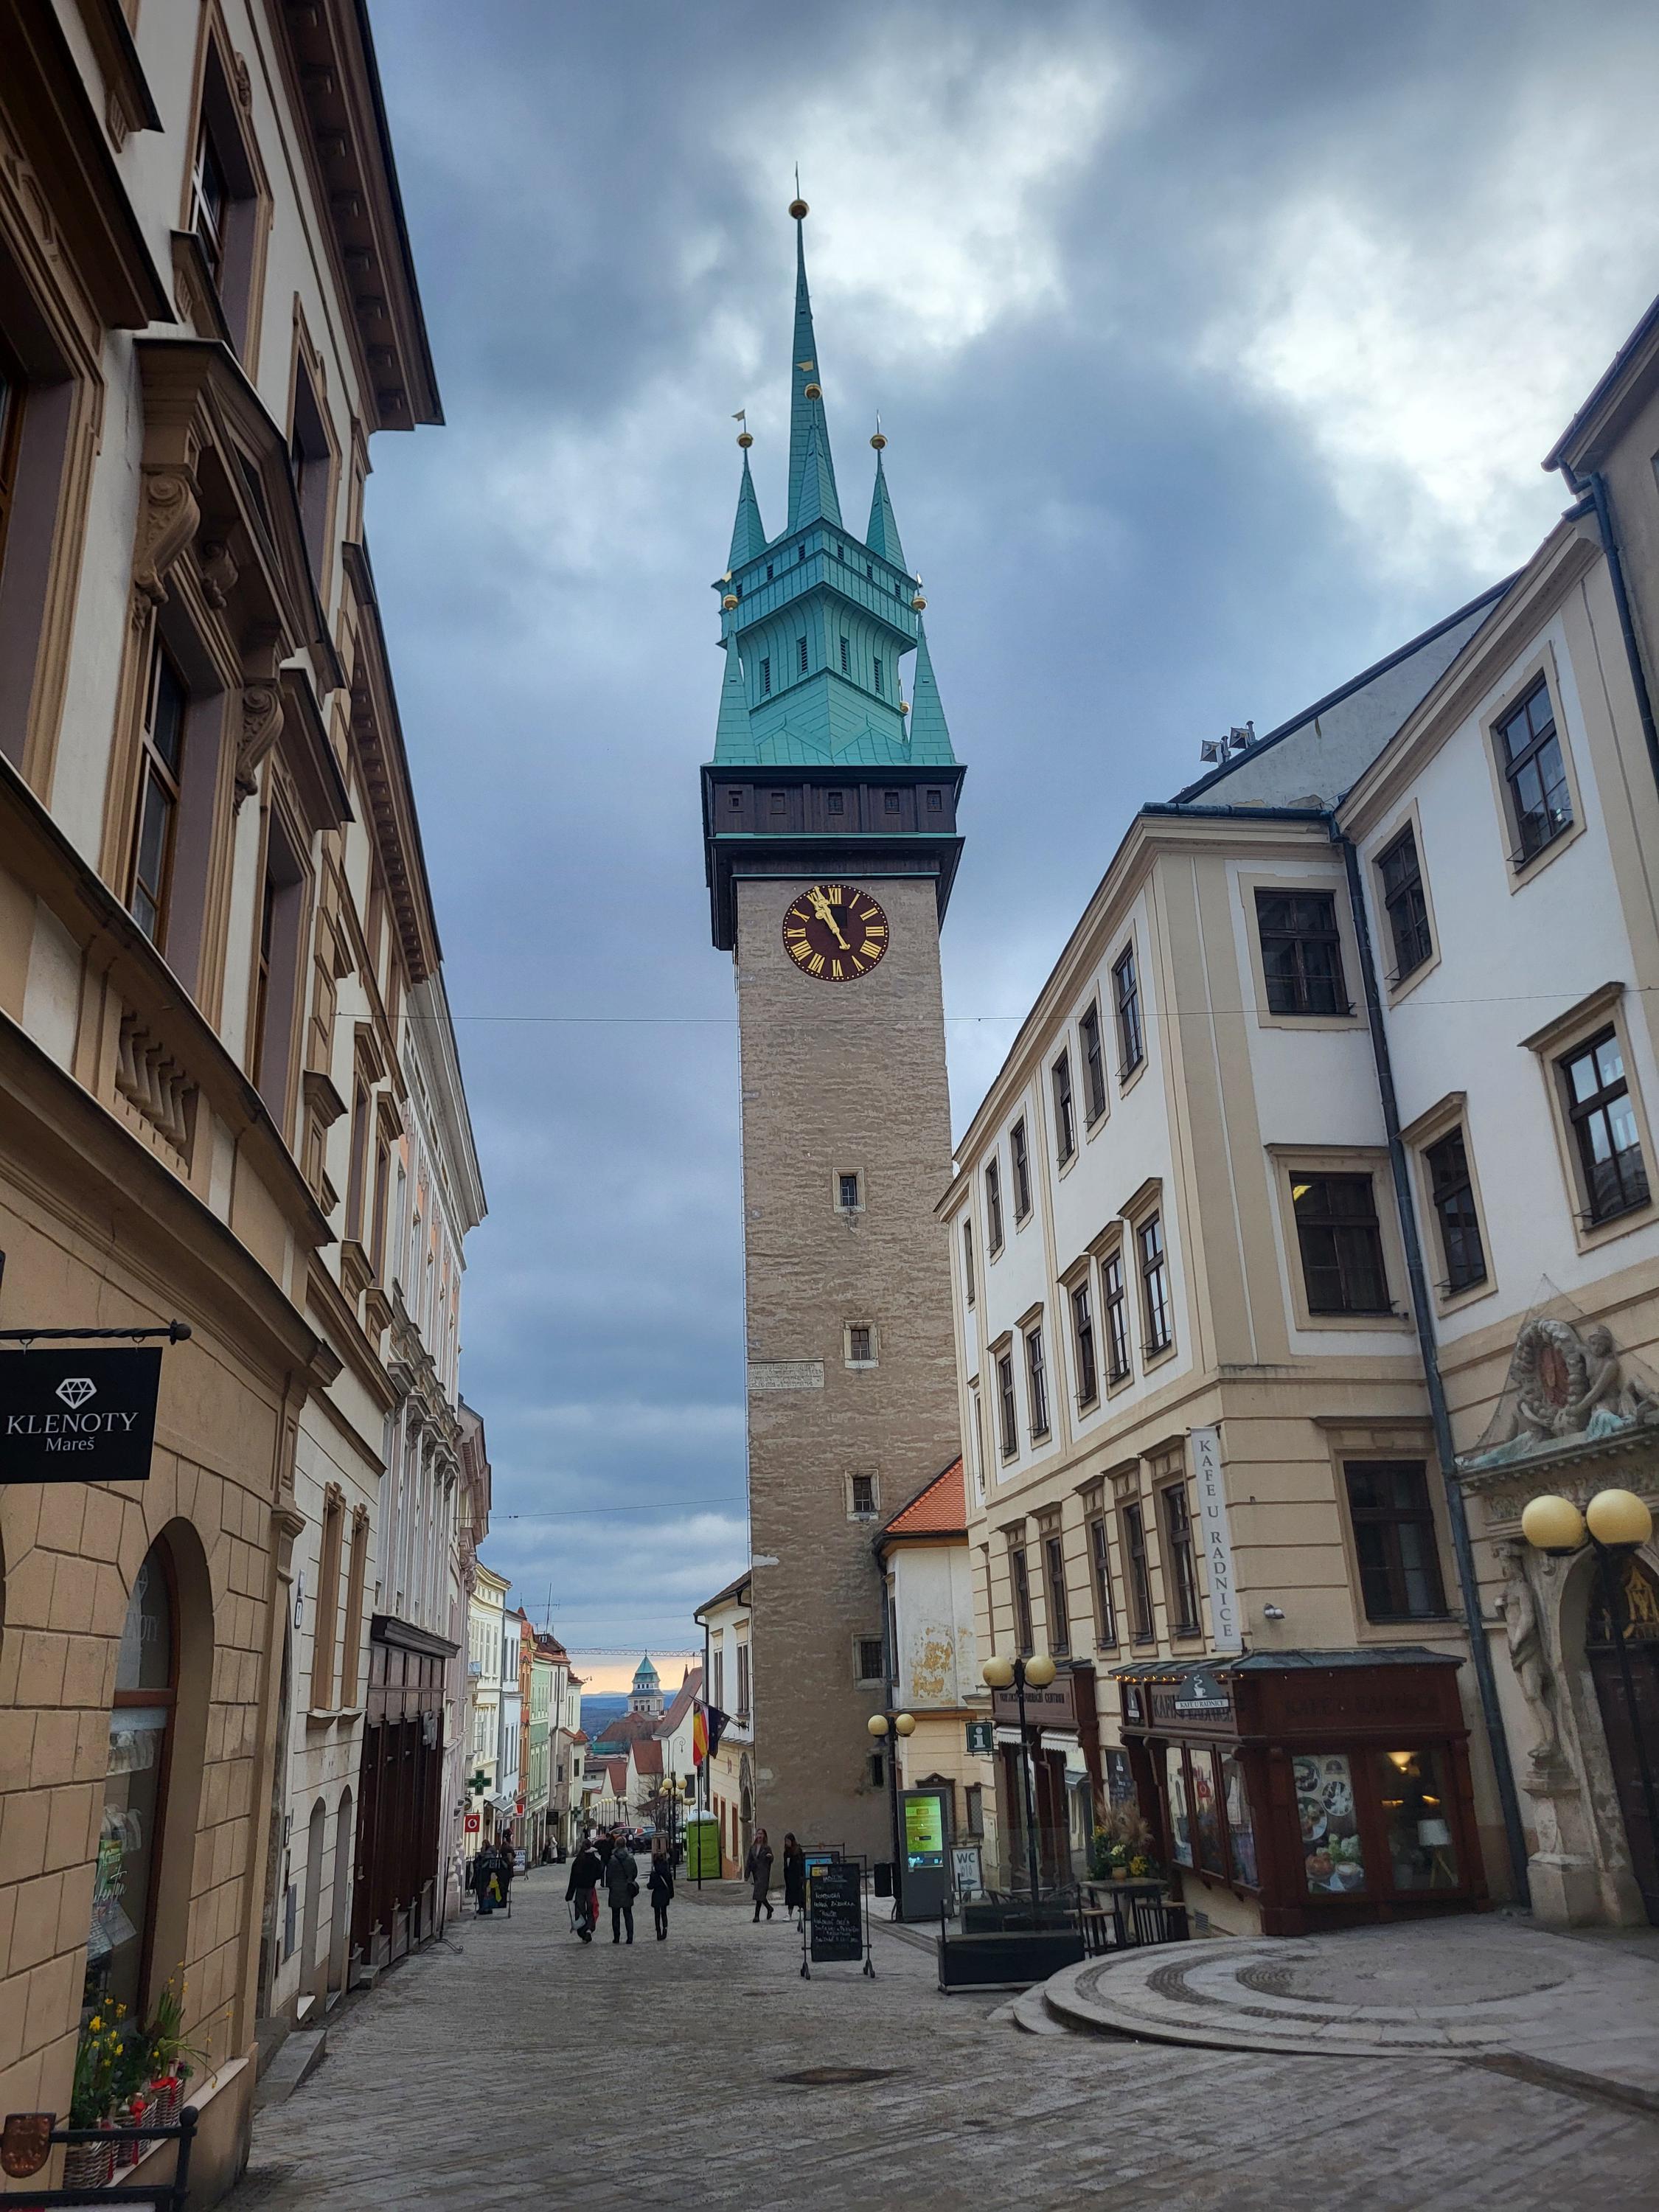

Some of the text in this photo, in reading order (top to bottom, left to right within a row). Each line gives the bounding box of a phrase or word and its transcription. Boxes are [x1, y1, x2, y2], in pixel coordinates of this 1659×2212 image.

[5, 1412, 139, 1435] KLENOTY
[45, 1436, 95, 1452] Mareš
[1198, 1440, 1234, 1637] KAFE U RADNICE
[956, 1852, 975, 1864] WC
